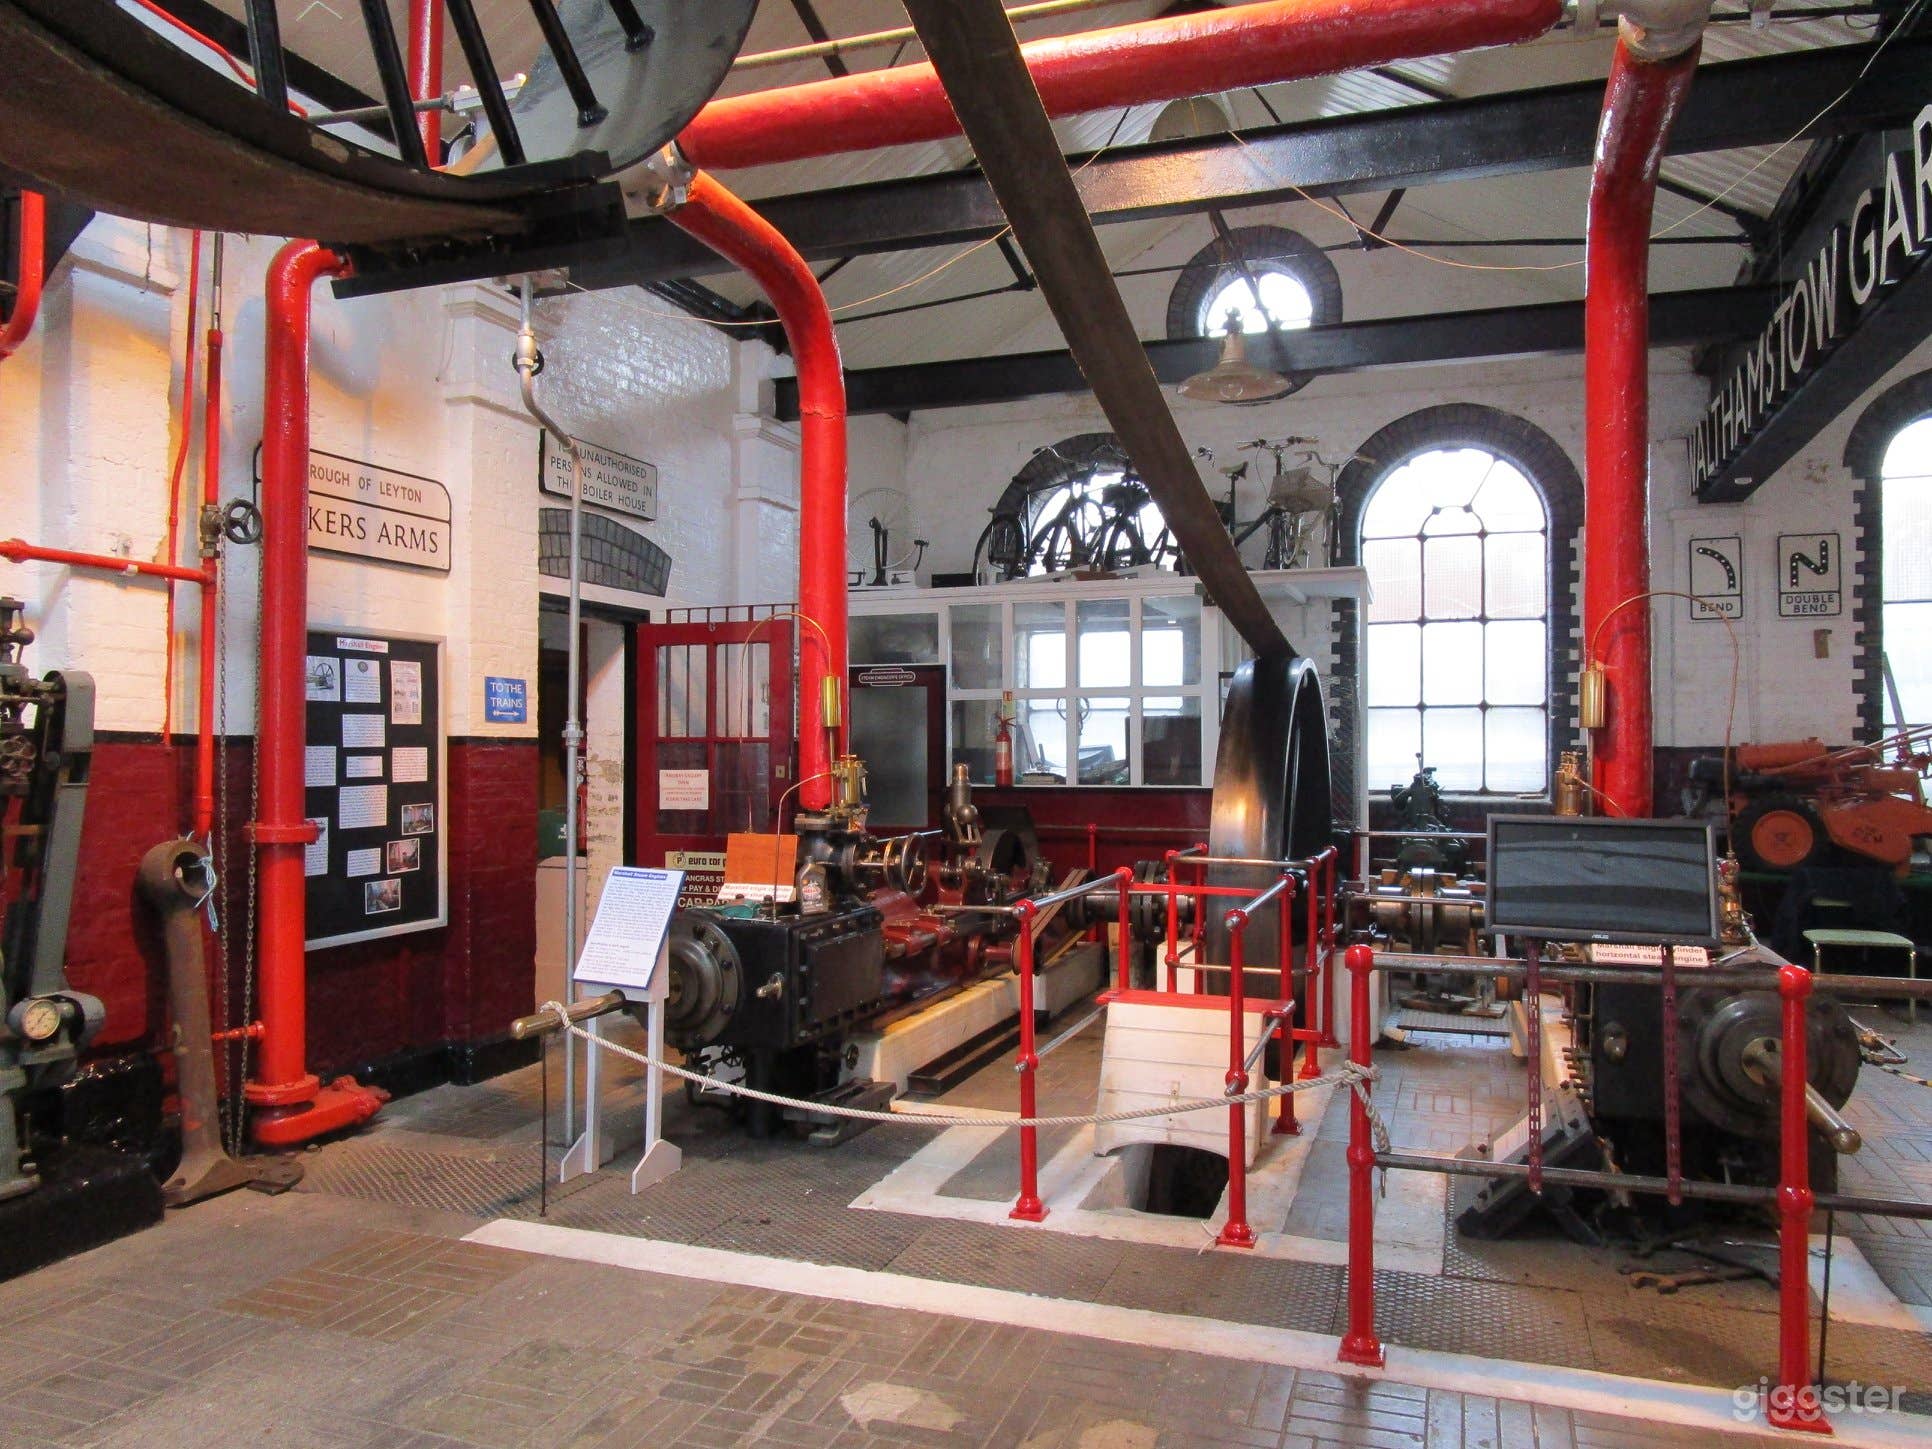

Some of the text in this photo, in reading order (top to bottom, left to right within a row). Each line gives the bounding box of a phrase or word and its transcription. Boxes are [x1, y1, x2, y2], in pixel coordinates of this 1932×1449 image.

[1687, 227, 1838, 497] WALTHAMSTOW
[579, 448, 647, 479] UNAUTHORISED
[550, 456, 653, 497] PERSNS ALLOWED IN
[358, 476, 372, 491] OF
[379, 481, 422, 503] LEYTON
[557, 475, 646, 512] THI BOILER HOUSE
[377, 521, 438, 554] ARMS
[1785, 594, 1835, 604] DOUBLE
[1700, 602, 1734, 612] BEND
[1793, 603, 1828, 613] BEND
[490, 681, 523, 694] TO THE
[490, 696, 523, 709] TRAINS
[688, 857, 707, 866] euro
[1596, 951, 1640, 960] horizontal
